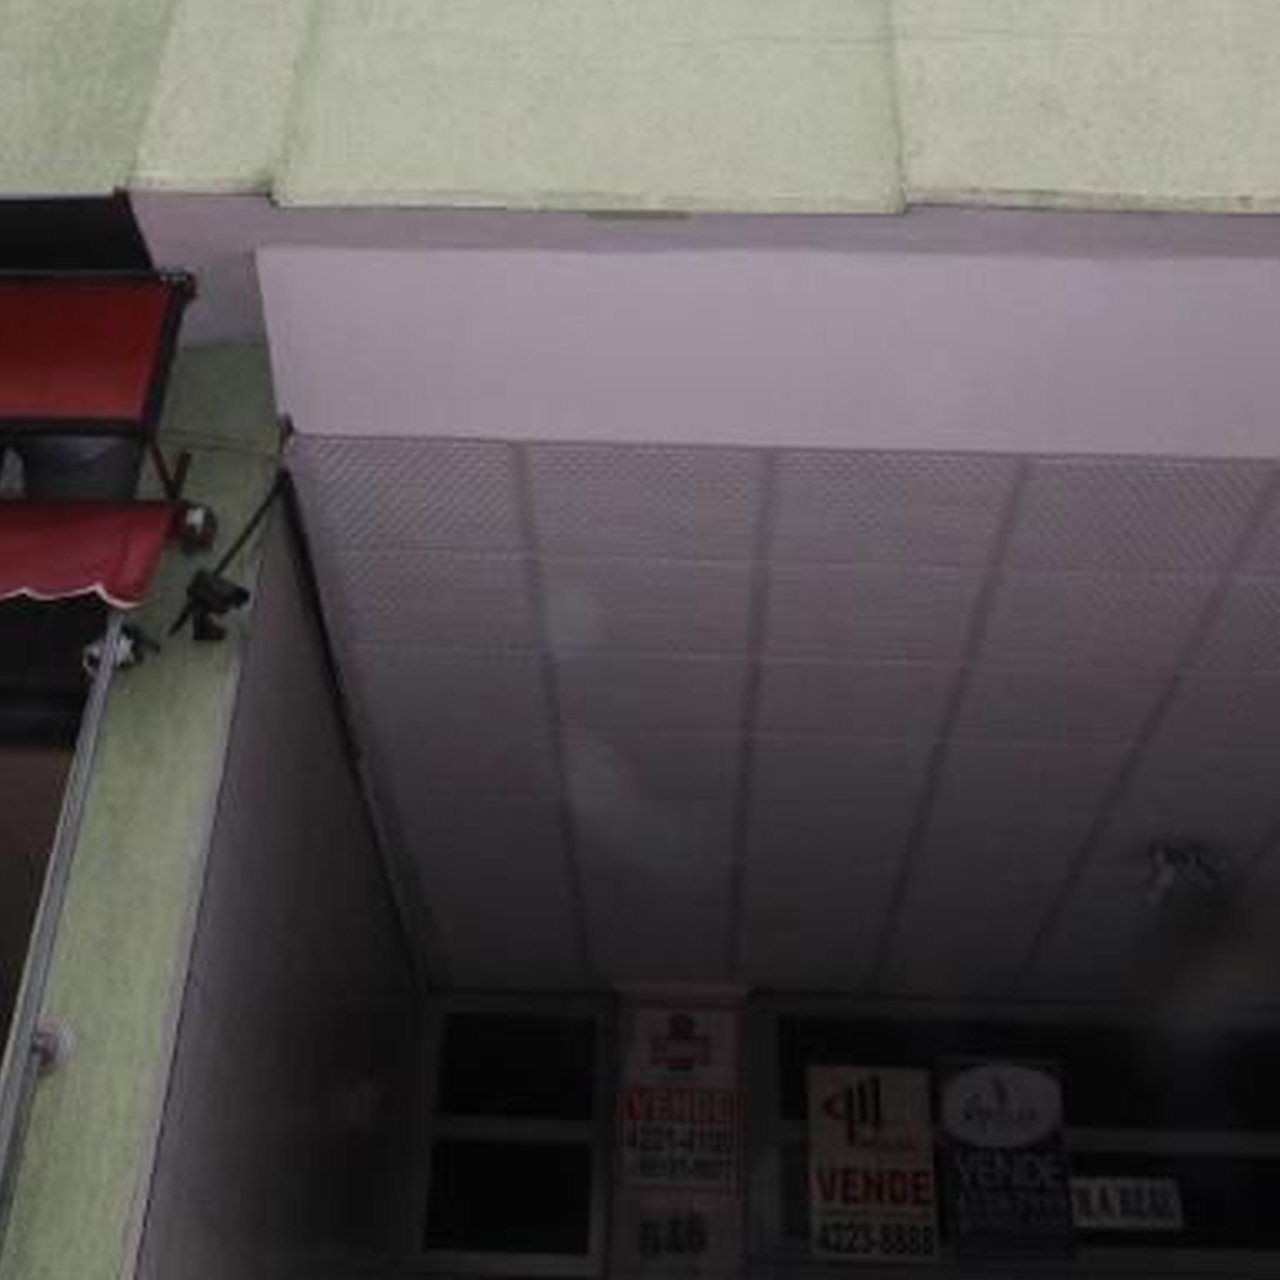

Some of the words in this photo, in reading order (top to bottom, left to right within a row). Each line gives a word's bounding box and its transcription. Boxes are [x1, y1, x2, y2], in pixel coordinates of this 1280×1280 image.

[622, 1090, 738, 1121] VENDE
[818, 1169, 934, 1206] VENDE
[955, 1150, 1064, 1189] VENDE
